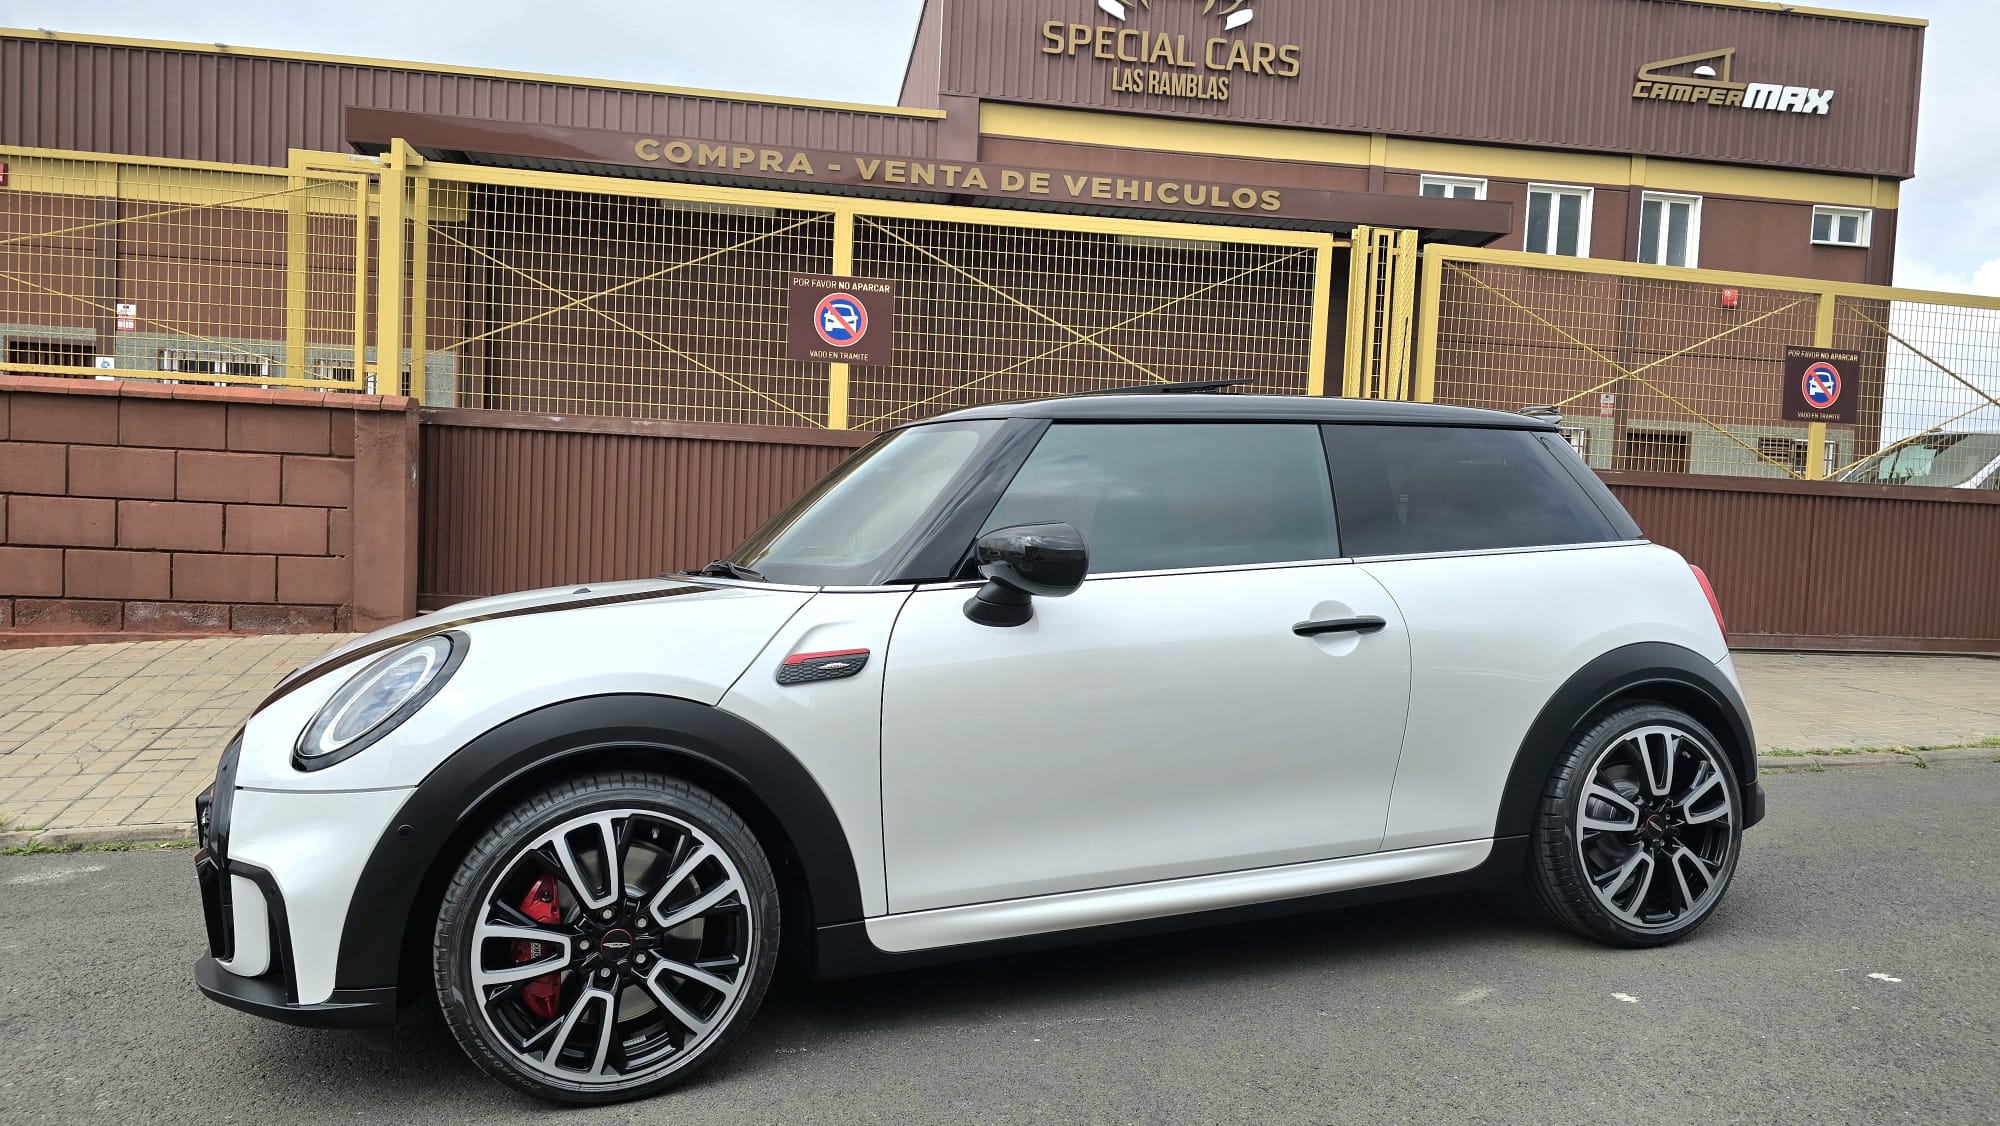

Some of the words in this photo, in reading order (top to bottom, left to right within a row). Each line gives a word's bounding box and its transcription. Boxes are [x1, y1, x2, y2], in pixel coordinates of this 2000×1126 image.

[1042, 20, 1196, 67] SPECIAL
[1205, 37, 1300, 77] CARS
[1112, 66, 1144, 92] LAS
[1148, 70, 1229, 101] RAMBLAS
[634, 138, 814, 175] COMPRA
[855, 157, 988, 190] VENTA
[1000, 169, 1050, 194] DE
[1063, 174, 1281, 211] VEHICULOS
[793, 277, 810, 287] POR
[811, 279, 837, 289] FAVOR
[838, 281, 850, 290] NO
[852, 282, 890, 293] APARCAR
[809, 350, 827, 359] VADO
[829, 351, 838, 359] EN
[840, 352, 869, 361] TRAMITE
[1787, 349, 1800, 358] POR
[1820, 352, 1829, 360] NO
[1830, 353, 1858, 362] APARCAR
